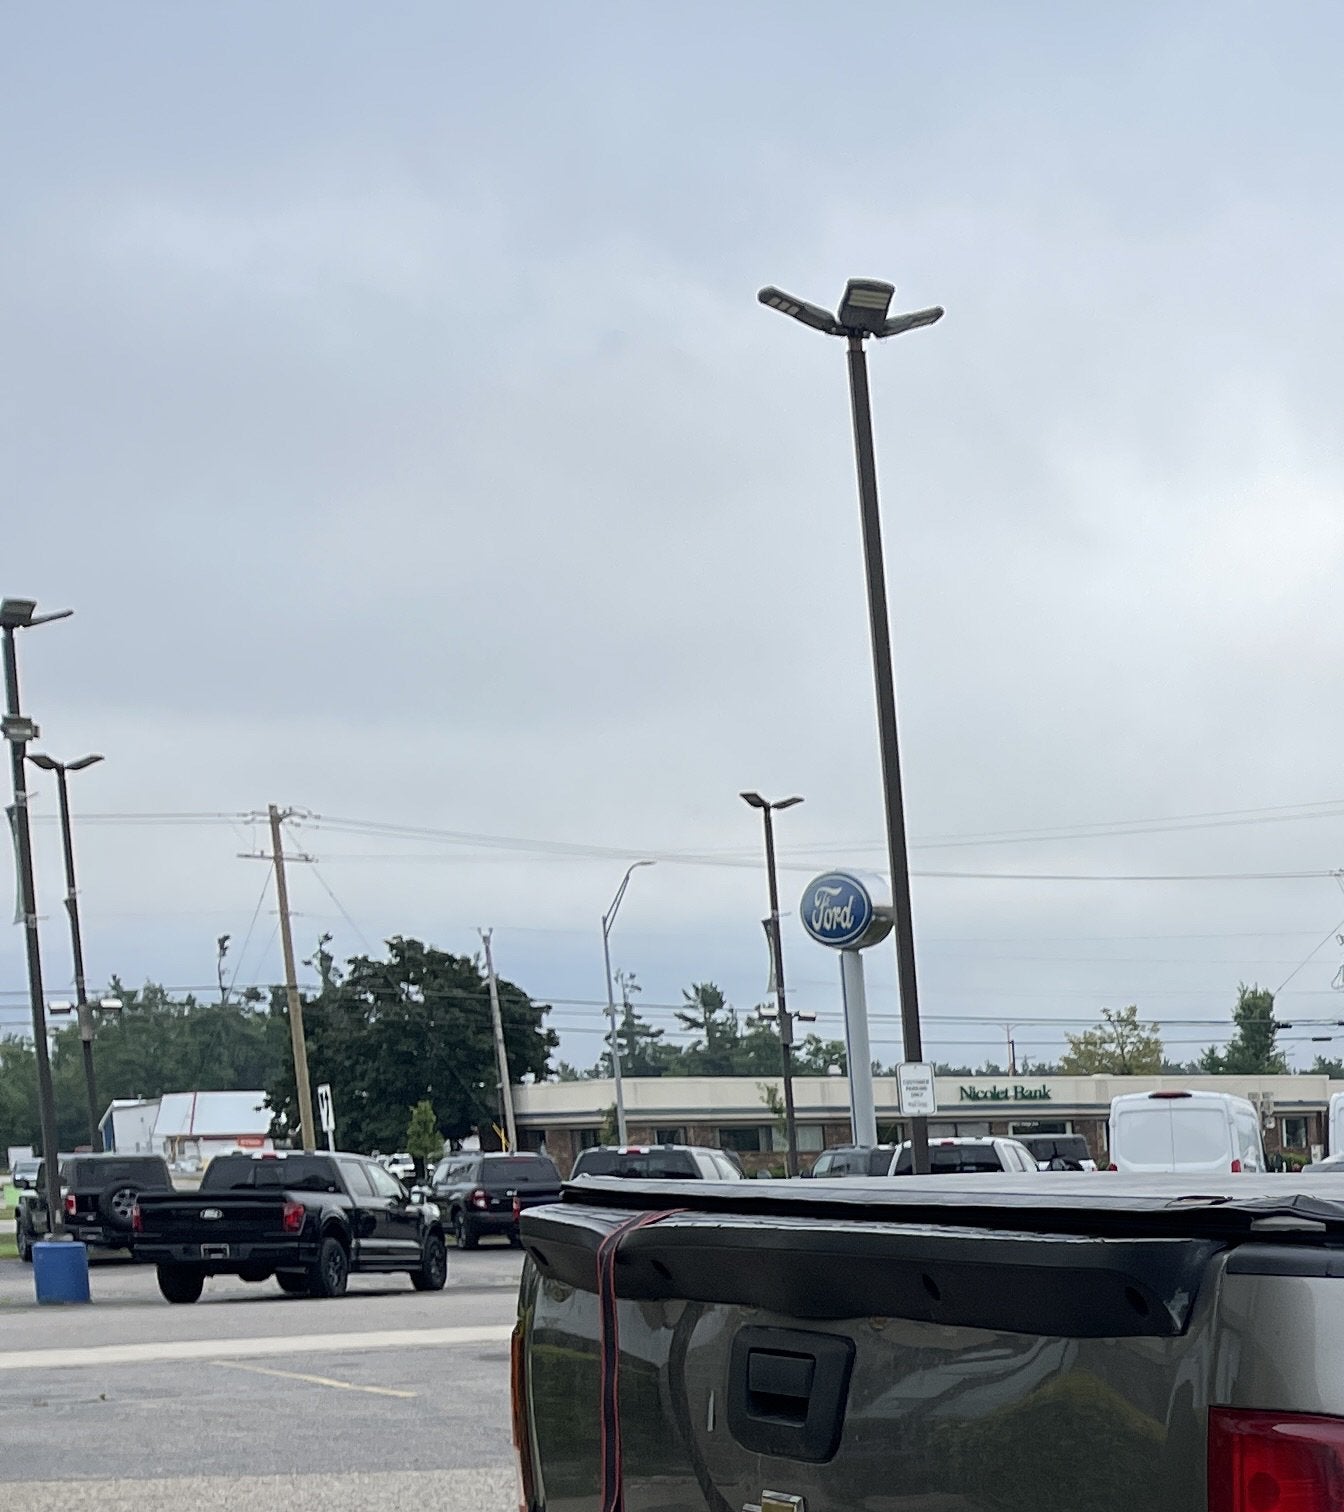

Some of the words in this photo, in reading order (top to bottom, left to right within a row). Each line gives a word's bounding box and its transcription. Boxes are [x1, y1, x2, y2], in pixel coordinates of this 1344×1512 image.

[811, 886, 855, 931] Ford
[960, 1084, 1008, 1100] Nicolet
[1013, 1084, 1052, 1100] Bank
